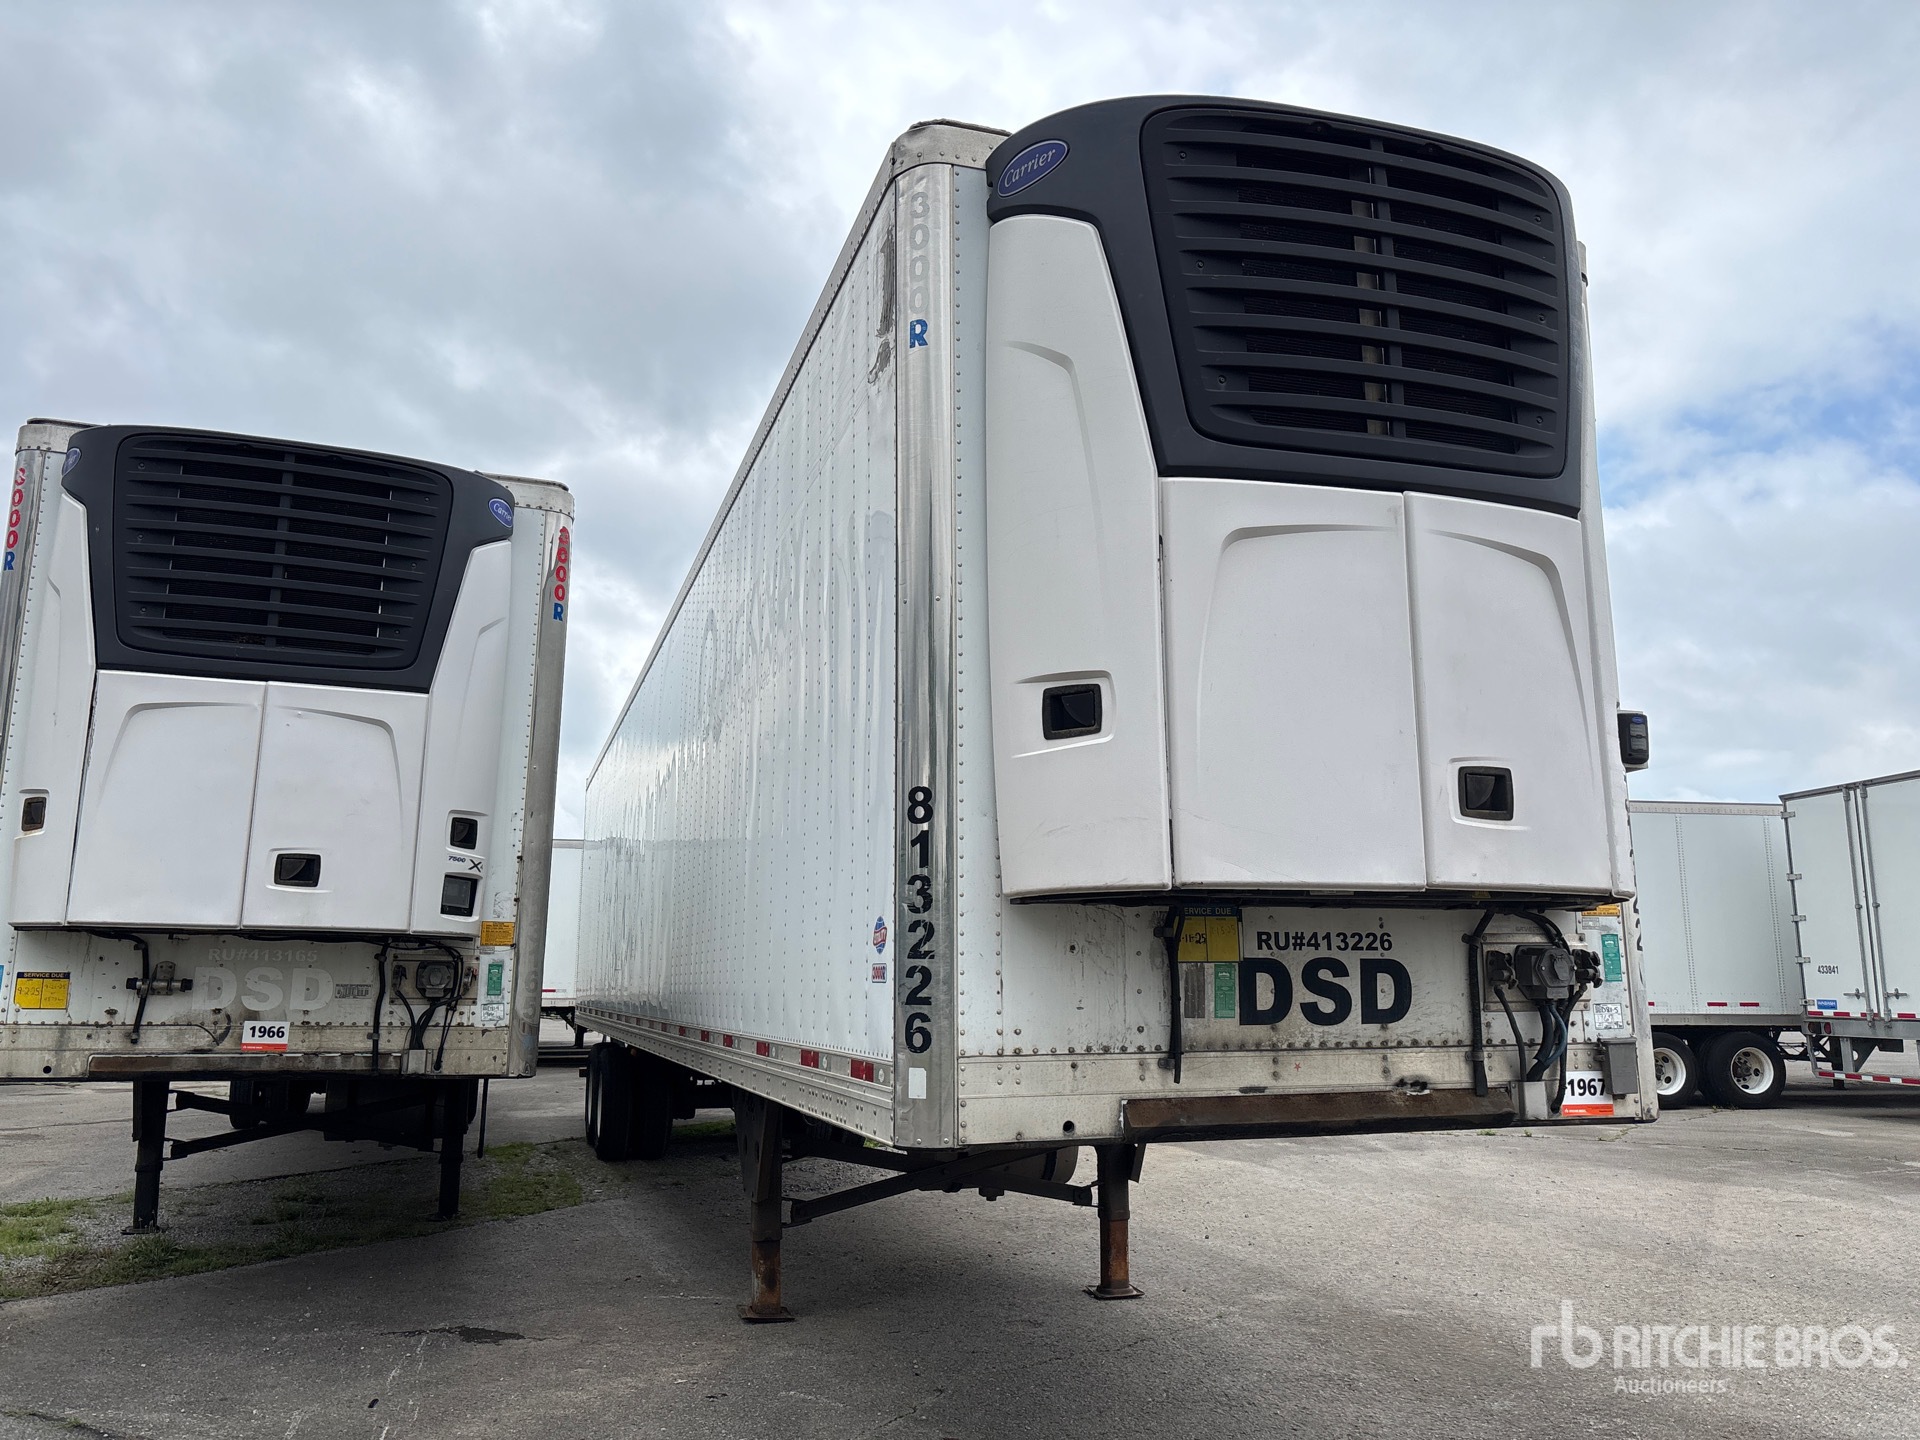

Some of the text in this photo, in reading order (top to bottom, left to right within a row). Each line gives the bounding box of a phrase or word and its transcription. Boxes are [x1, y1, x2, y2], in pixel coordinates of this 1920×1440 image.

[1004, 149, 1056, 188] Carrier
[909, 191, 931, 349] 3000R
[3, 467, 26, 571] 3000R
[904, 785, 936, 1054] 813226
[1184, 907, 1232, 915] ERVICE DUE
[208, 948, 318, 962] RU#413165
[1256, 931, 1393, 951] RU#413226
[191, 966, 334, 1012] DSD
[1239, 957, 1412, 1026] DSD
[249, 1025, 286, 1039] 1966
[1567, 1077, 1606, 1097] 1967
